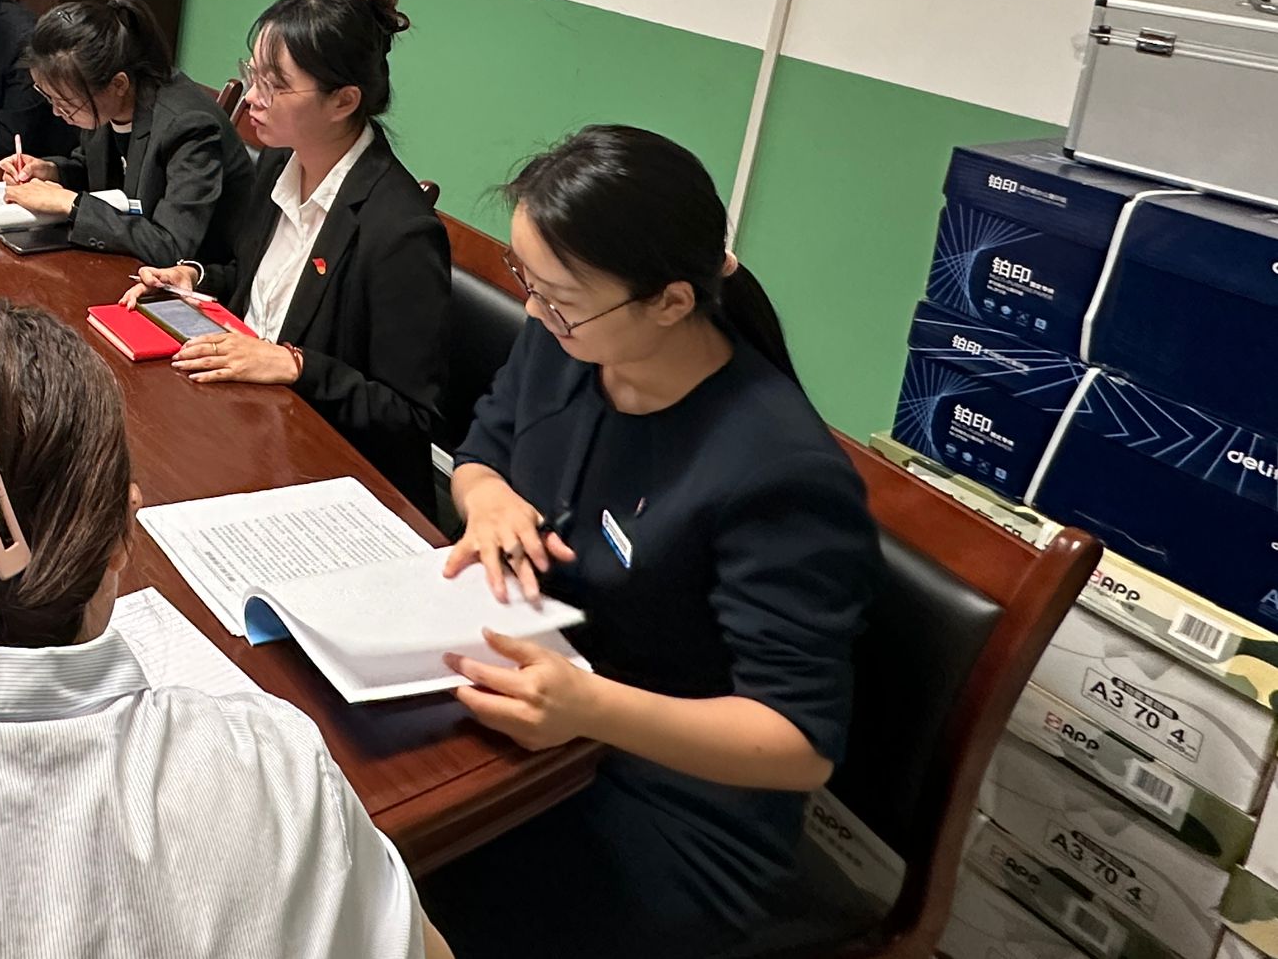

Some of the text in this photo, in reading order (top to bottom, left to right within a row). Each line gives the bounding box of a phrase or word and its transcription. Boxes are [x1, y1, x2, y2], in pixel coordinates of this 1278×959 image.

[988, 174, 1018, 193] 铂印
[992, 257, 1032, 283] 铂印
[951, 334, 982, 355] 铂印
[954, 404, 992, 432] 铂印
[1100, 576, 1141, 602] APP
[1090, 681, 1124, 708] A3
[1133, 702, 1160, 729] 70
[1170, 729, 1186, 743] 4
[1061, 724, 1100, 750] APP
[1051, 833, 1084, 861] A3
[1093, 857, 1119, 884] 70
[1127, 886, 1142, 901] 4
